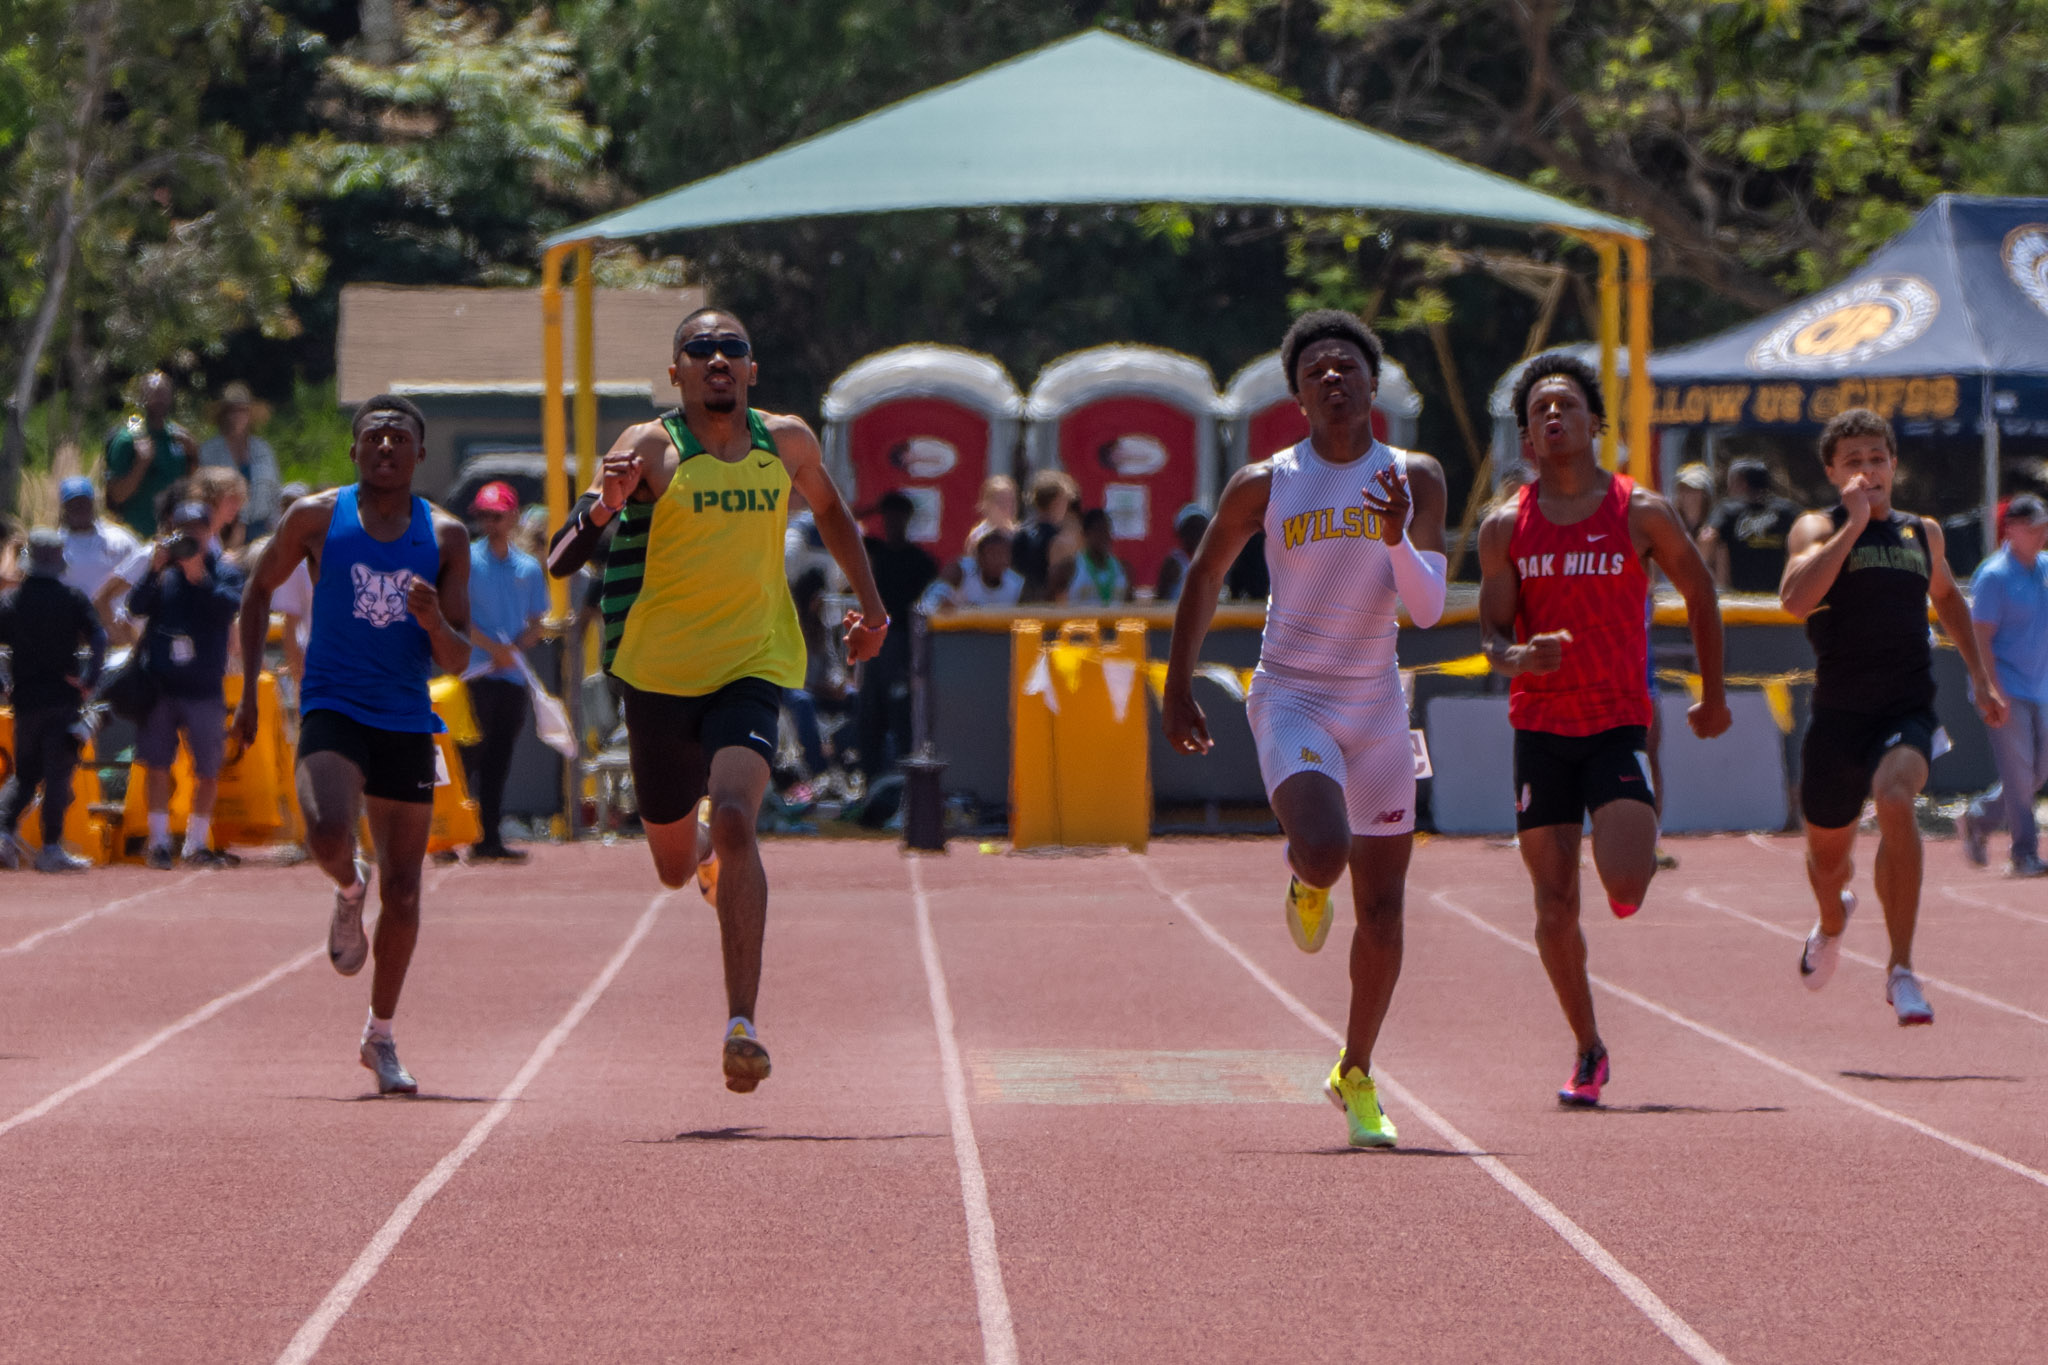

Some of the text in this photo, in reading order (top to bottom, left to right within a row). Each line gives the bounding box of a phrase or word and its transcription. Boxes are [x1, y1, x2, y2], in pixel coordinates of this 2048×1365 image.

[1650, 383, 1750, 424] LLOW
[693, 488, 780, 513] POLY
[1283, 507, 1382, 550] WILSO
[1563, 551, 1625, 576] HILLS
